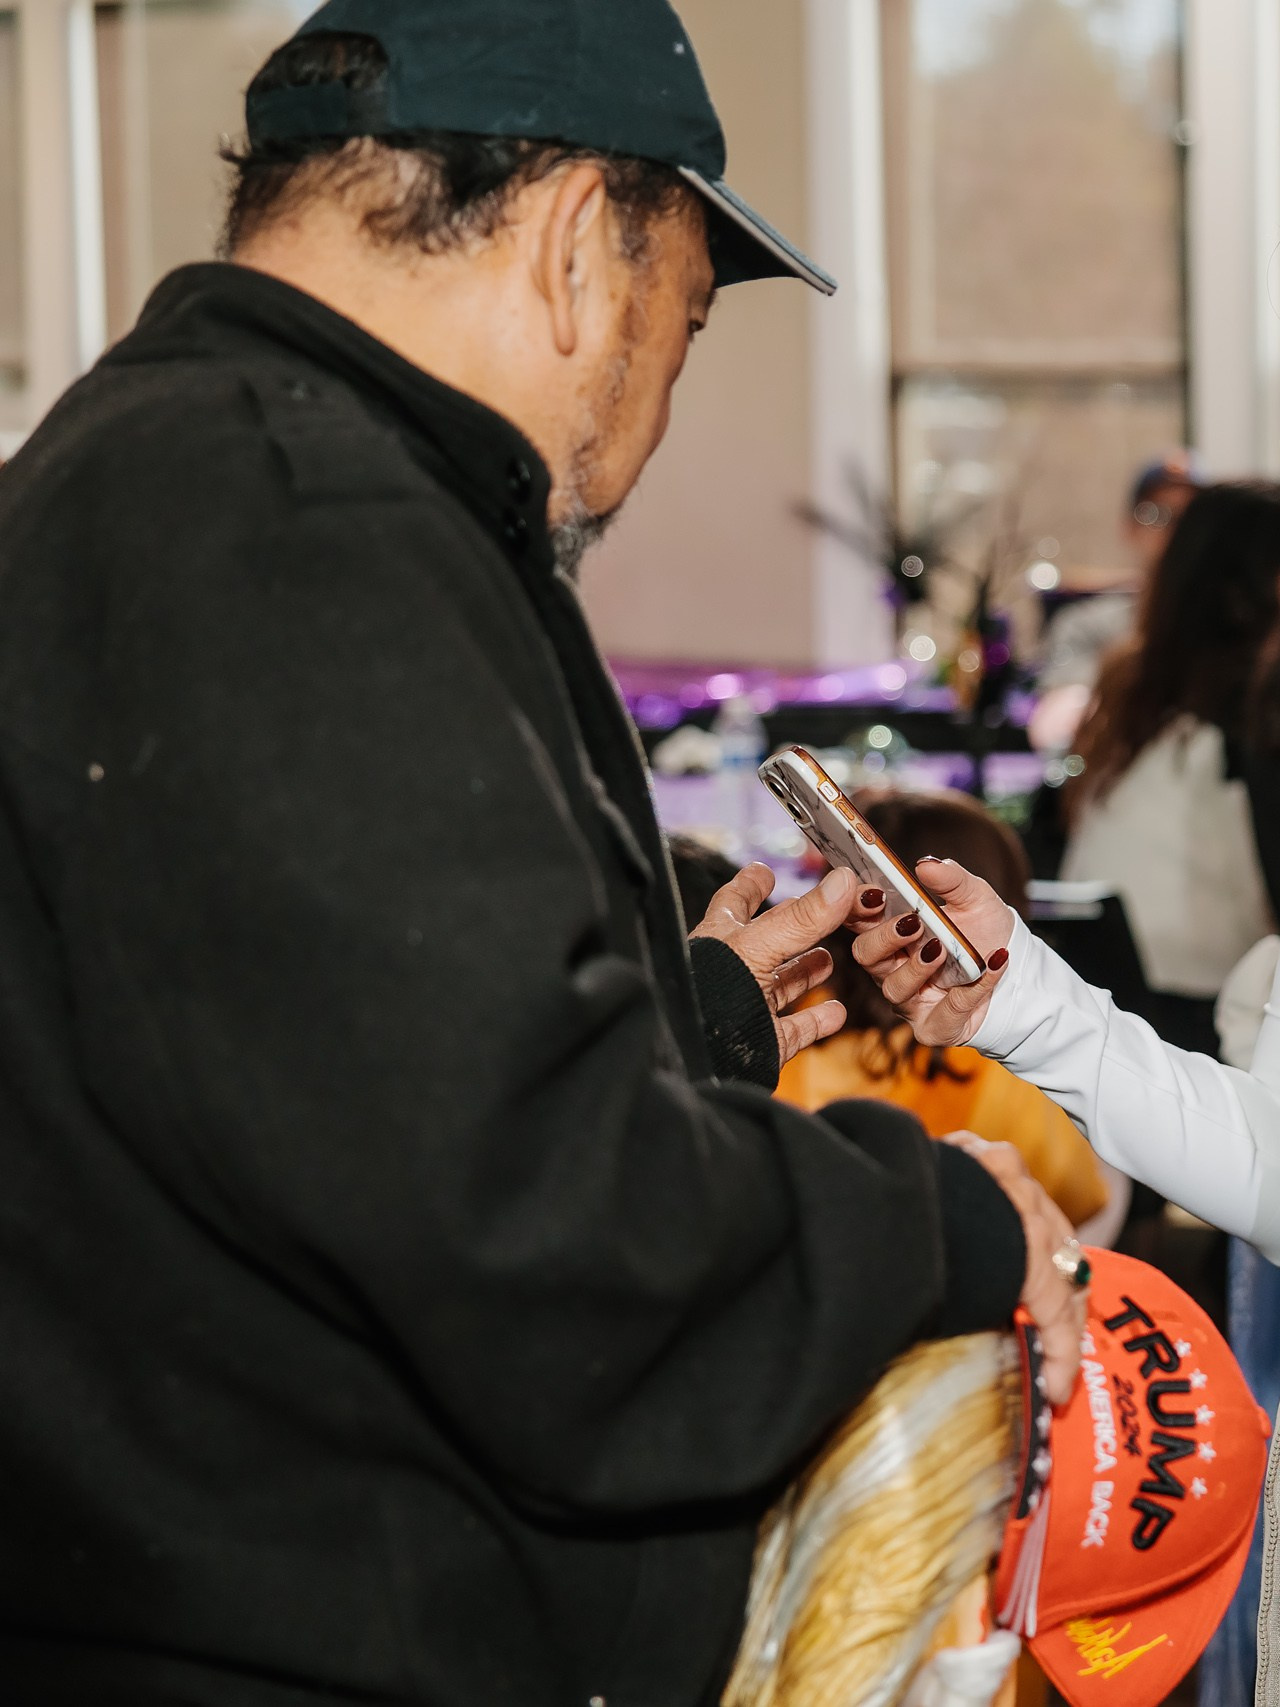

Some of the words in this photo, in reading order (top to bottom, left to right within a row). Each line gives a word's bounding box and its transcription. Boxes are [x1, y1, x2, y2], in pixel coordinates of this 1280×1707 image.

[1080, 1359, 1118, 1473] AMERICA
[1105, 1296, 1197, 1551] TRUMP
[1113, 1374, 1142, 1456] 2024
[1081, 1481, 1115, 1548] BACK
